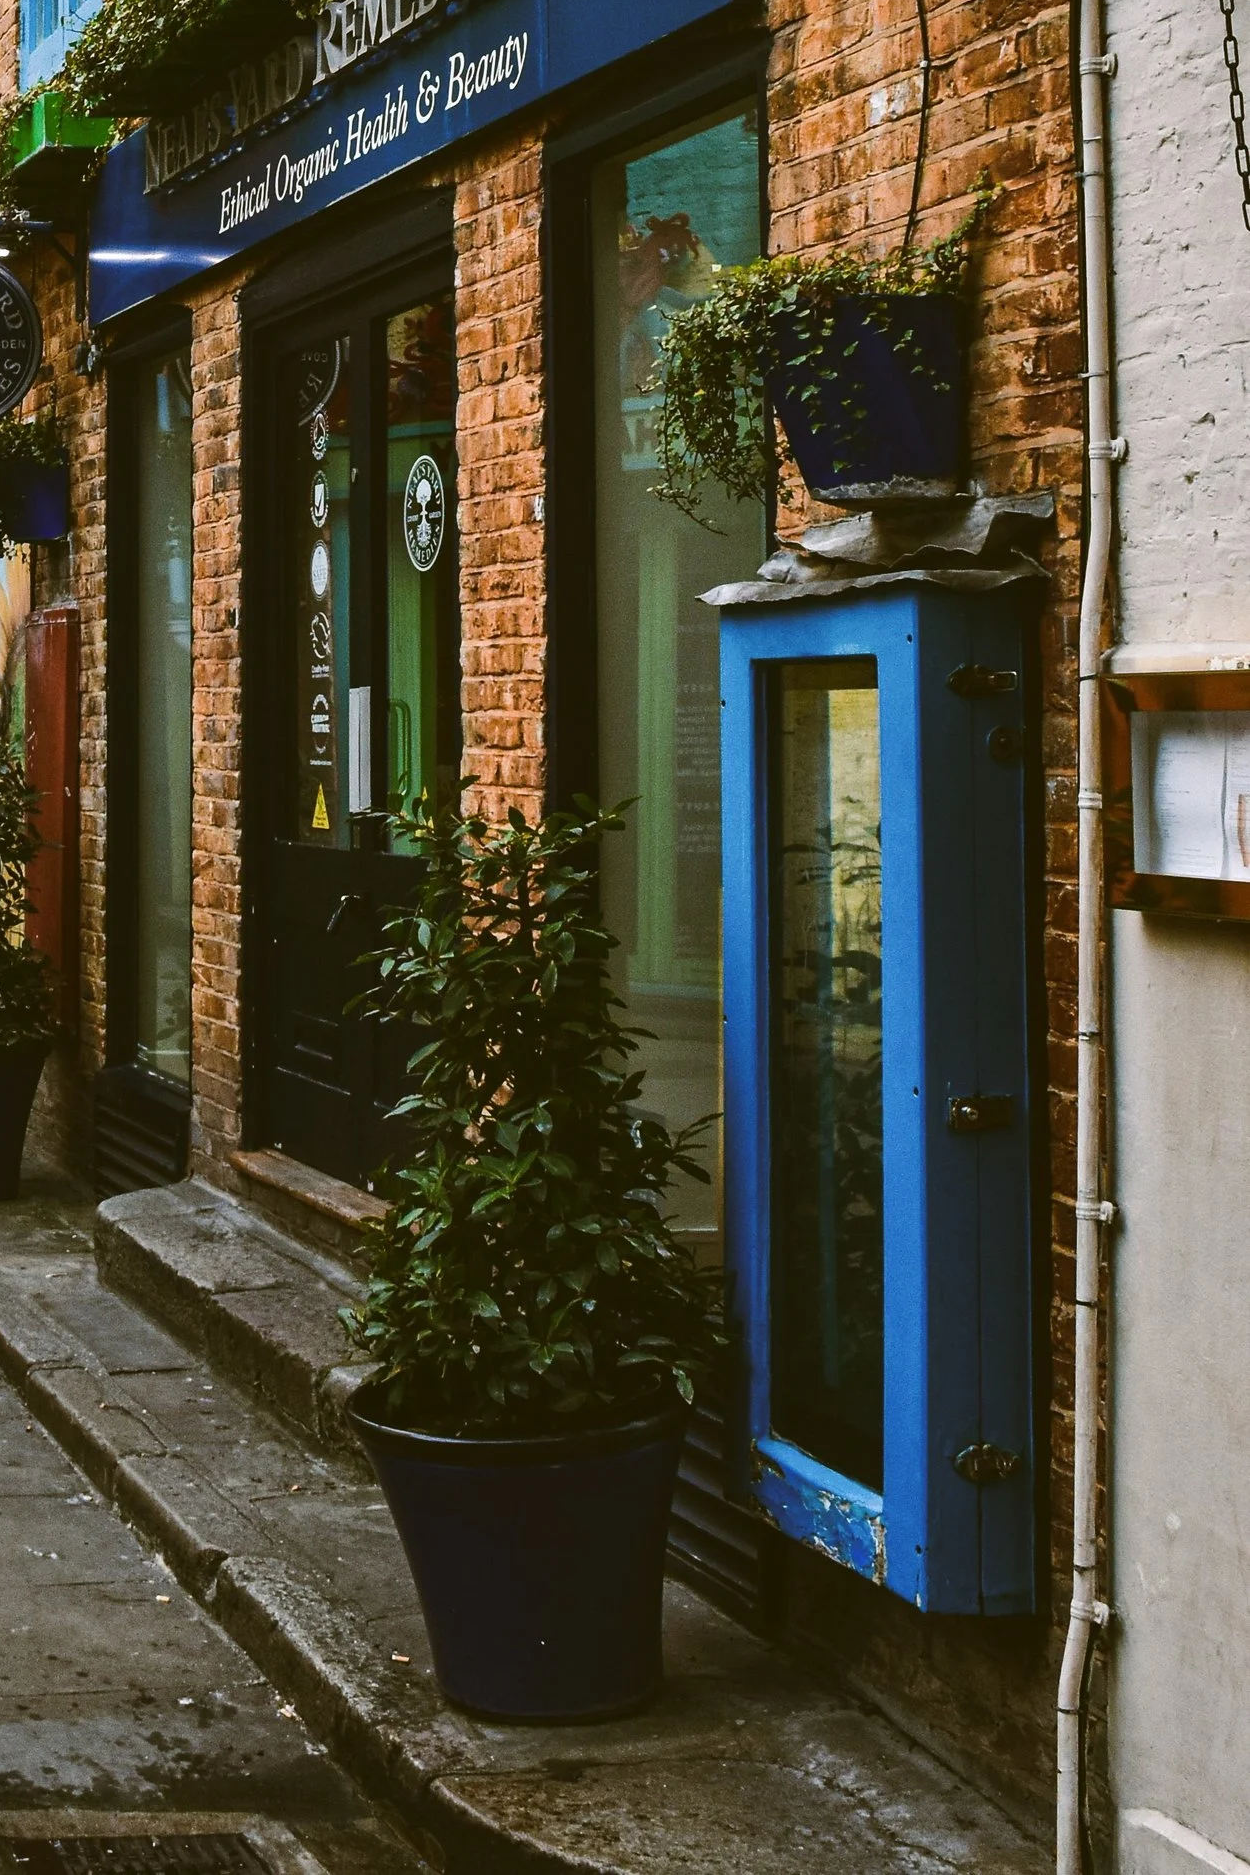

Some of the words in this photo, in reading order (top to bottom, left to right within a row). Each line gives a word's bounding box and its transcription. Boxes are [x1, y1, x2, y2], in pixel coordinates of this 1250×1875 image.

[218, 165, 270, 235] Ethical
[274, 127, 339, 204] Organic
[344, 84, 409, 166] Health
[415, 69, 441, 124] &
[444, 31, 529, 111] Beauty
